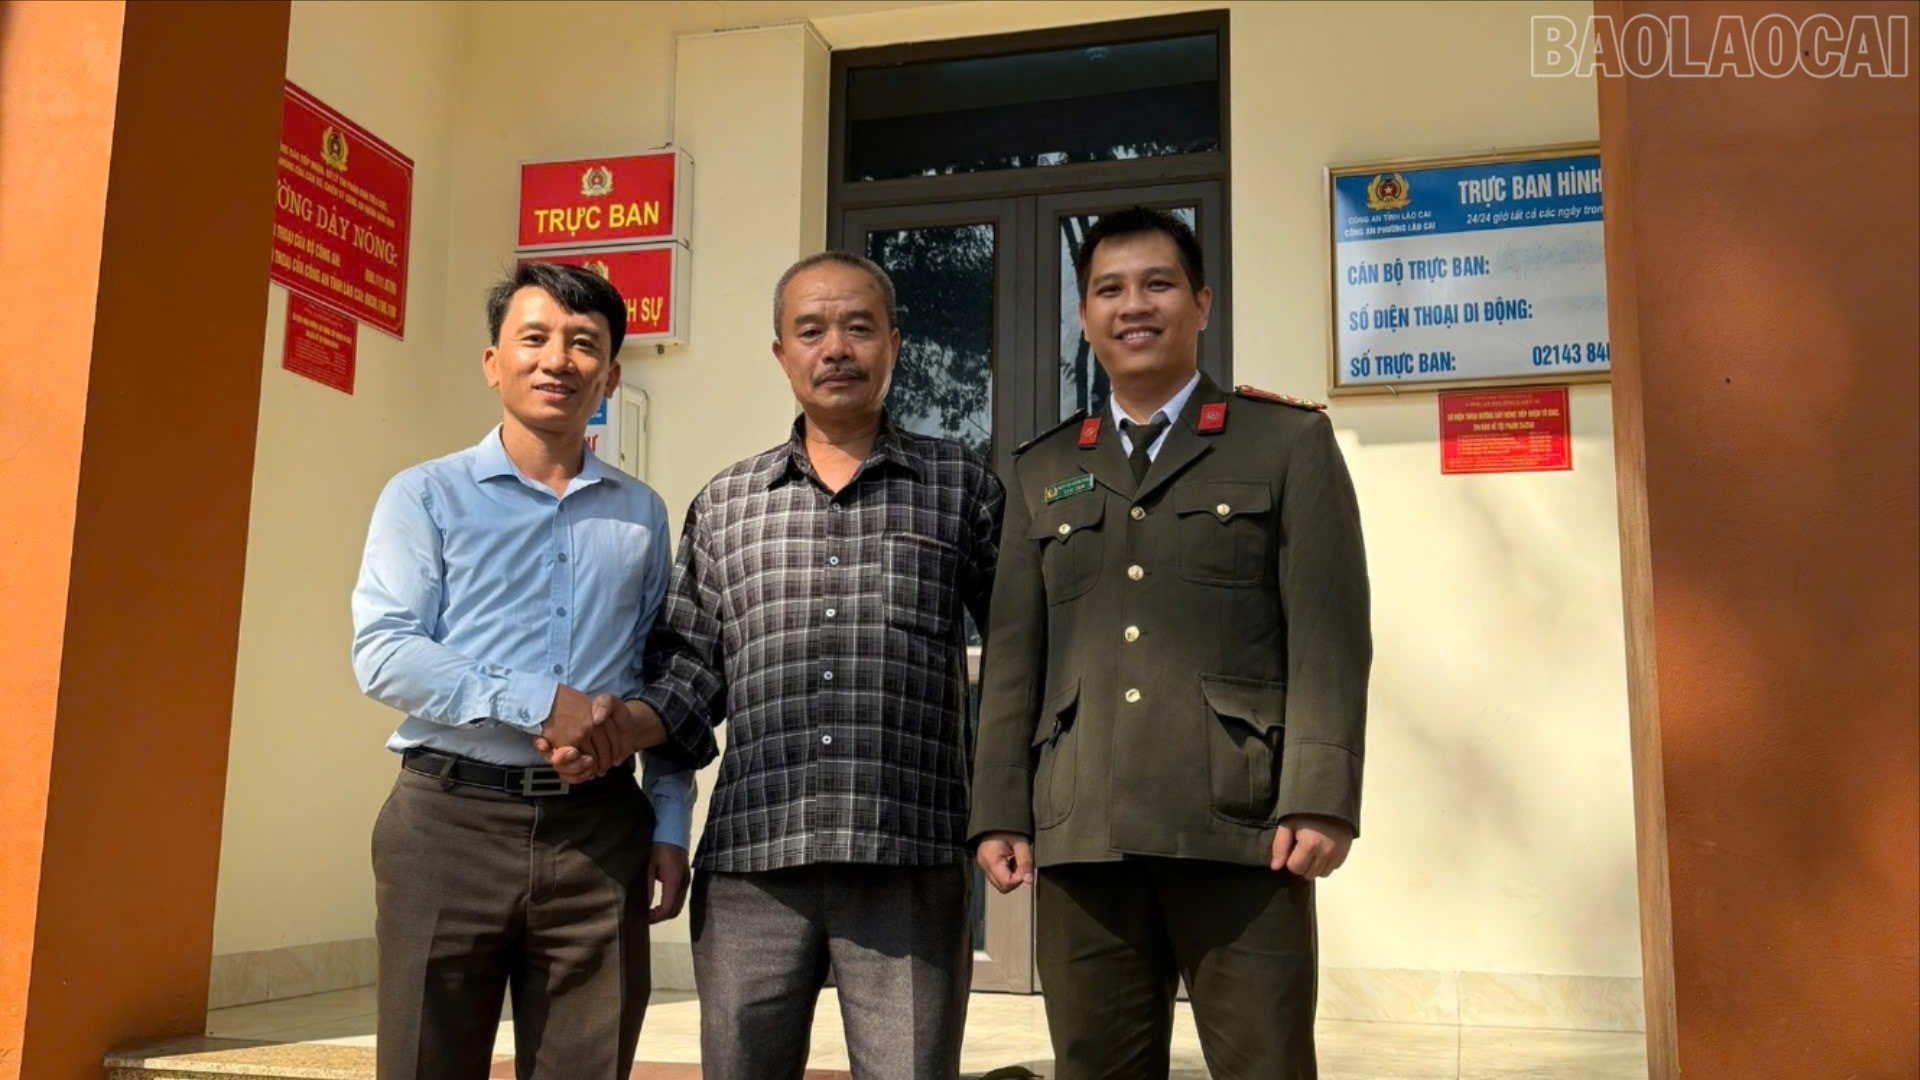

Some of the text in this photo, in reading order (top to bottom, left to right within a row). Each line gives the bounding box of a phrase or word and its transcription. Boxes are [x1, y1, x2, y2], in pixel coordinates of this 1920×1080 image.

[1458, 165, 1603, 208] TRỰC BAN HÌNH
[277, 178, 313, 222] ỜNG
[316, 204, 350, 241] DÂY
[352, 224, 398, 268] NÓNG:
[534, 201, 660, 237] TRỰC BAN
[1466, 213, 1491, 224] 24/24
[1347, 260, 1379, 286] CÁN
[1383, 258, 1403, 286] BỘ
[1408, 256, 1448, 283] TRỰC
[1452, 255, 1490, 277] BAN:
[641, 297, 663, 326] SỰ
[1349, 296, 1533, 333] SỐ ĐIỆN THOẠI DI ĐỘNG:
[1350, 349, 1370, 377] SỐ
[1375, 352, 1414, 379] TRỰC
[1419, 351, 1456, 373] BAN:
[1532, 343, 1581, 366] 02143
